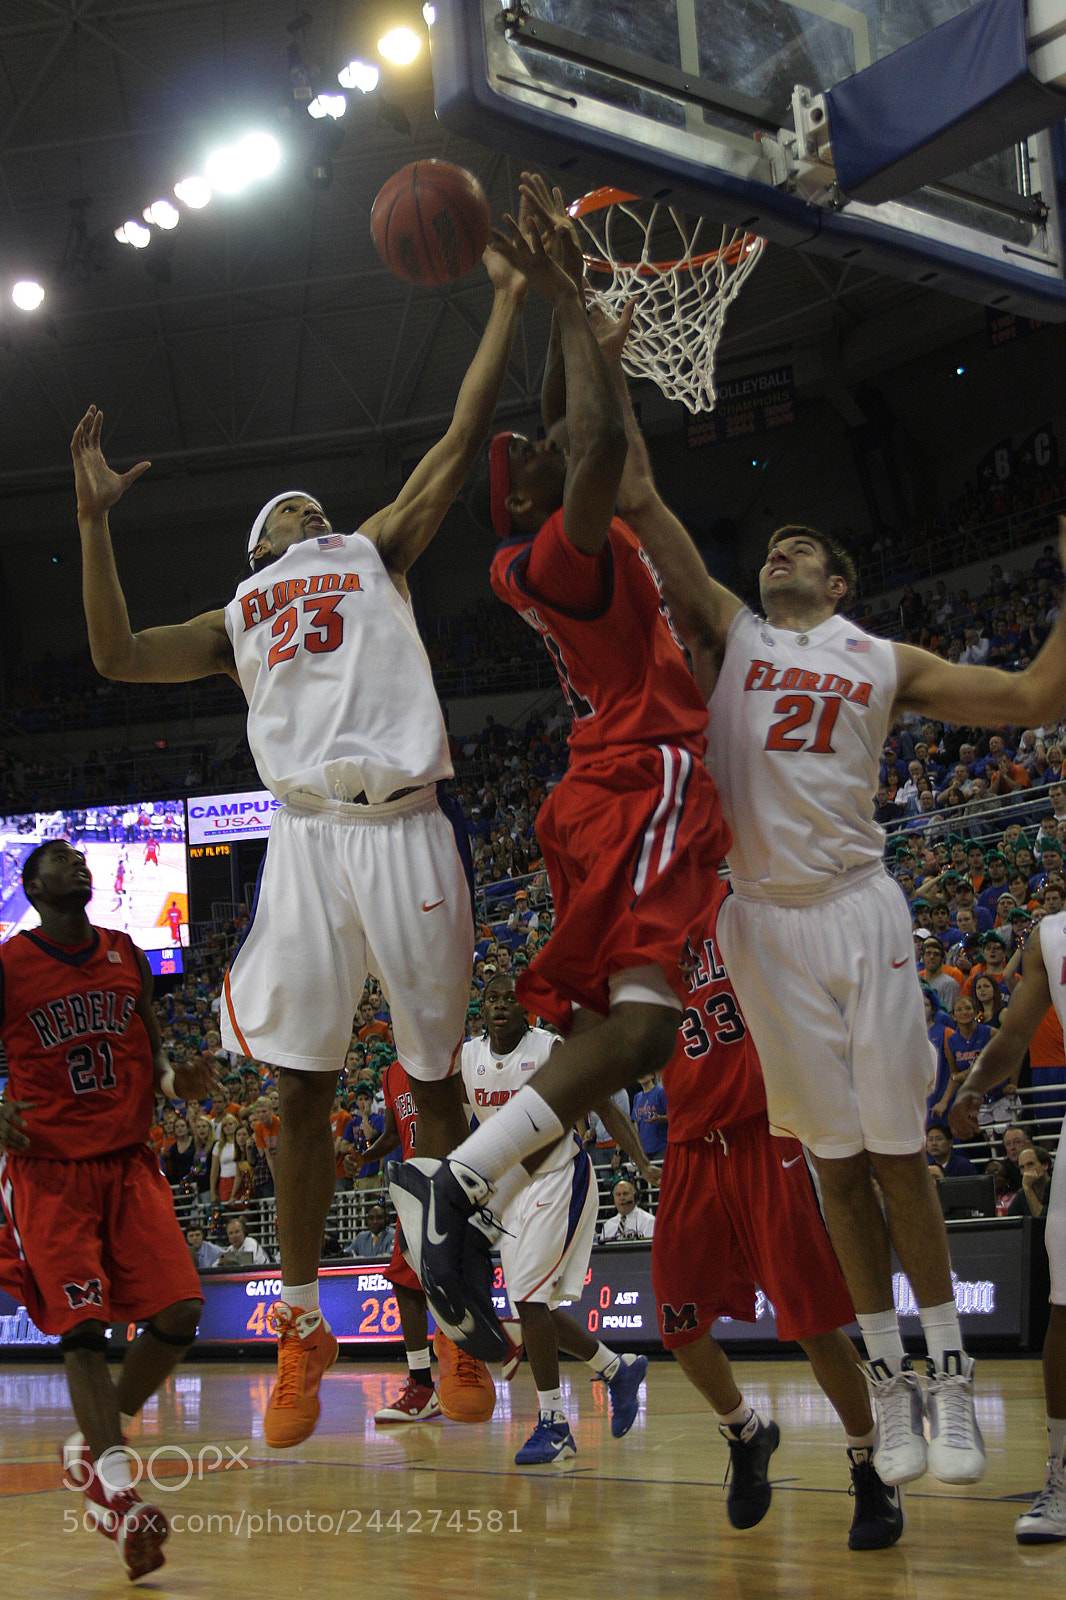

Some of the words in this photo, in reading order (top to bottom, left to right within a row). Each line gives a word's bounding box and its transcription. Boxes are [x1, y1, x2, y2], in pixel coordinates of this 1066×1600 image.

[238, 573, 364, 632] FLORIDA
[267, 594, 345, 671] 23
[744, 659, 873, 707] FLORIDA
[764, 694, 842, 753] 21
[190, 799, 281, 819] CAMPUS
[214, 816, 262, 828] USA
[26, 990, 135, 1050] REBELS
[679, 991, 746, 1060] 33
[65, 1041, 117, 1095] 21
[358, 1297, 402, 1334] 28
[587, 1308, 599, 1333] 0
[602, 1315, 643, 1329] FOULS
[599, 1285, 611, 1309] 0
[614, 1291, 639, 1305] AST
[661, 1303, 699, 1334] M
